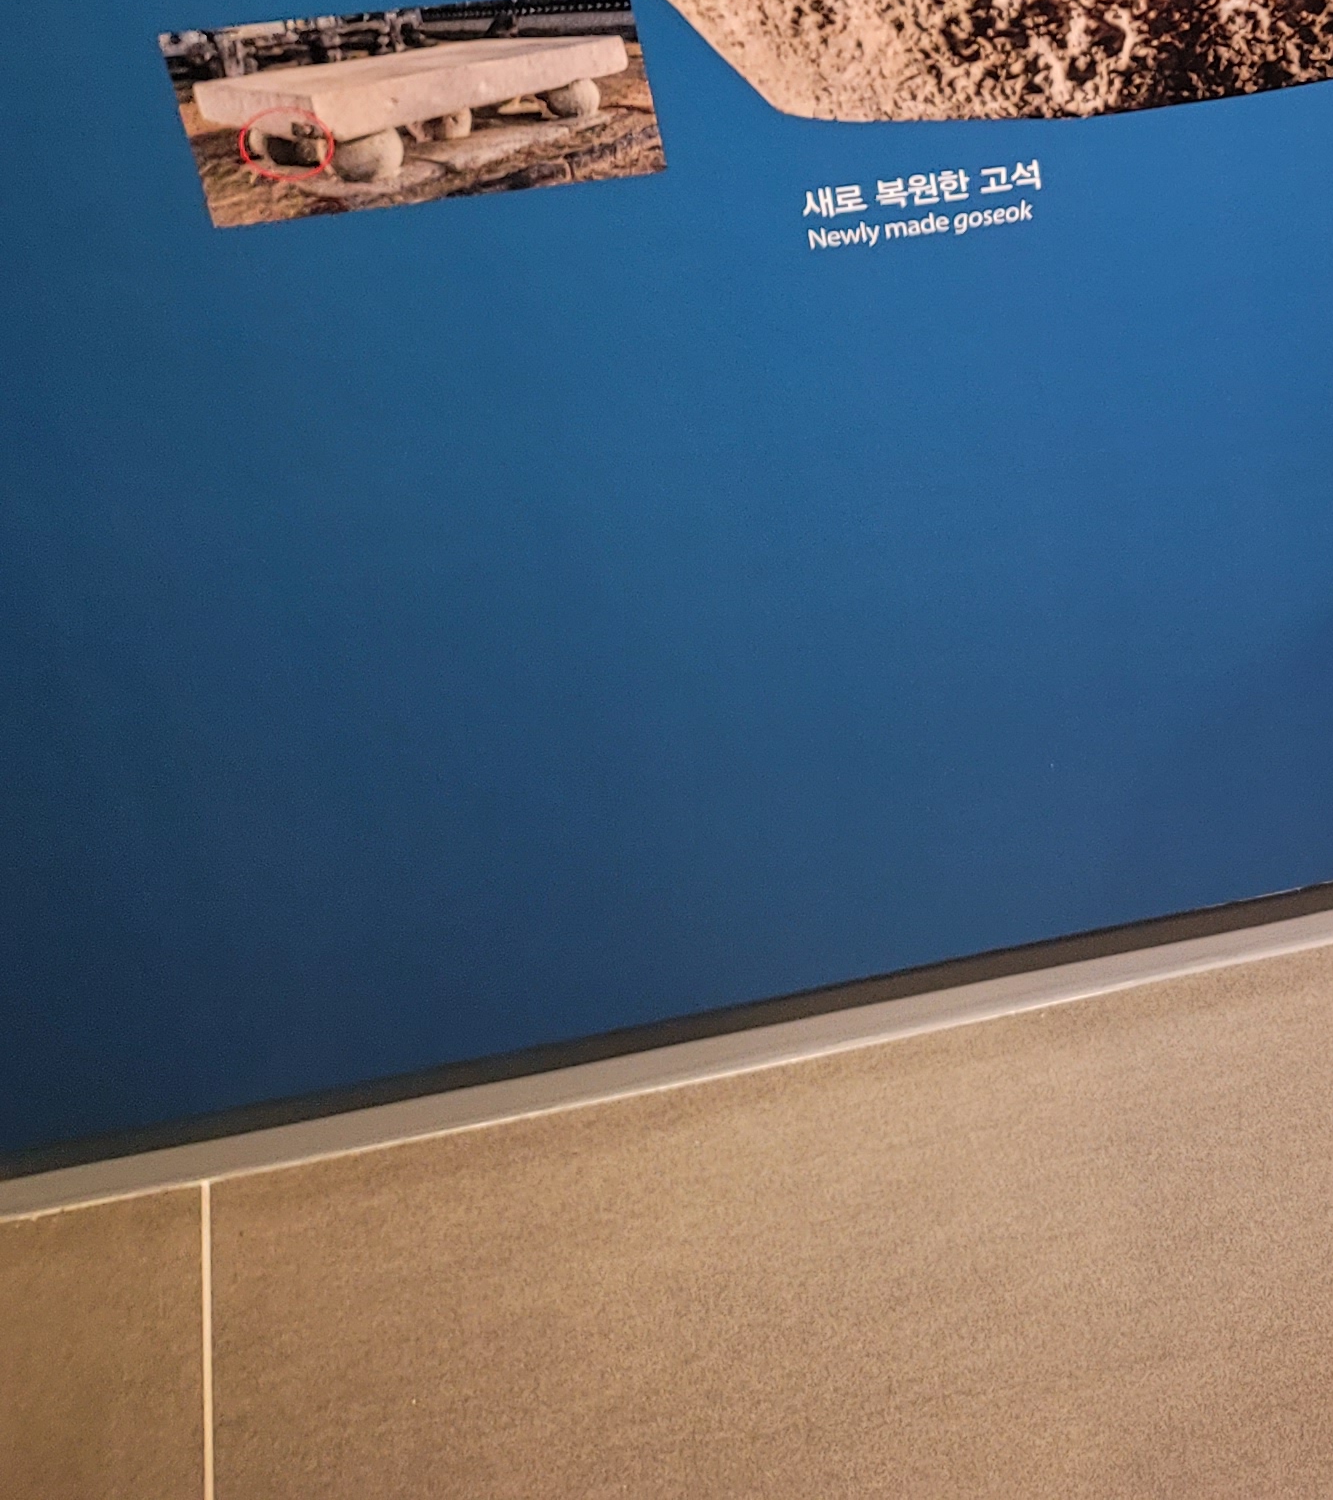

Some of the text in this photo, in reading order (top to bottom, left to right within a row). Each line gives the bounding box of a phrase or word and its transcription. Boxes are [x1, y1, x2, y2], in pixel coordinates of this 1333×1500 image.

[803, 159, 1042, 218] 새로 복원한 고석
[808, 199, 1033, 250] Newly made goseok
